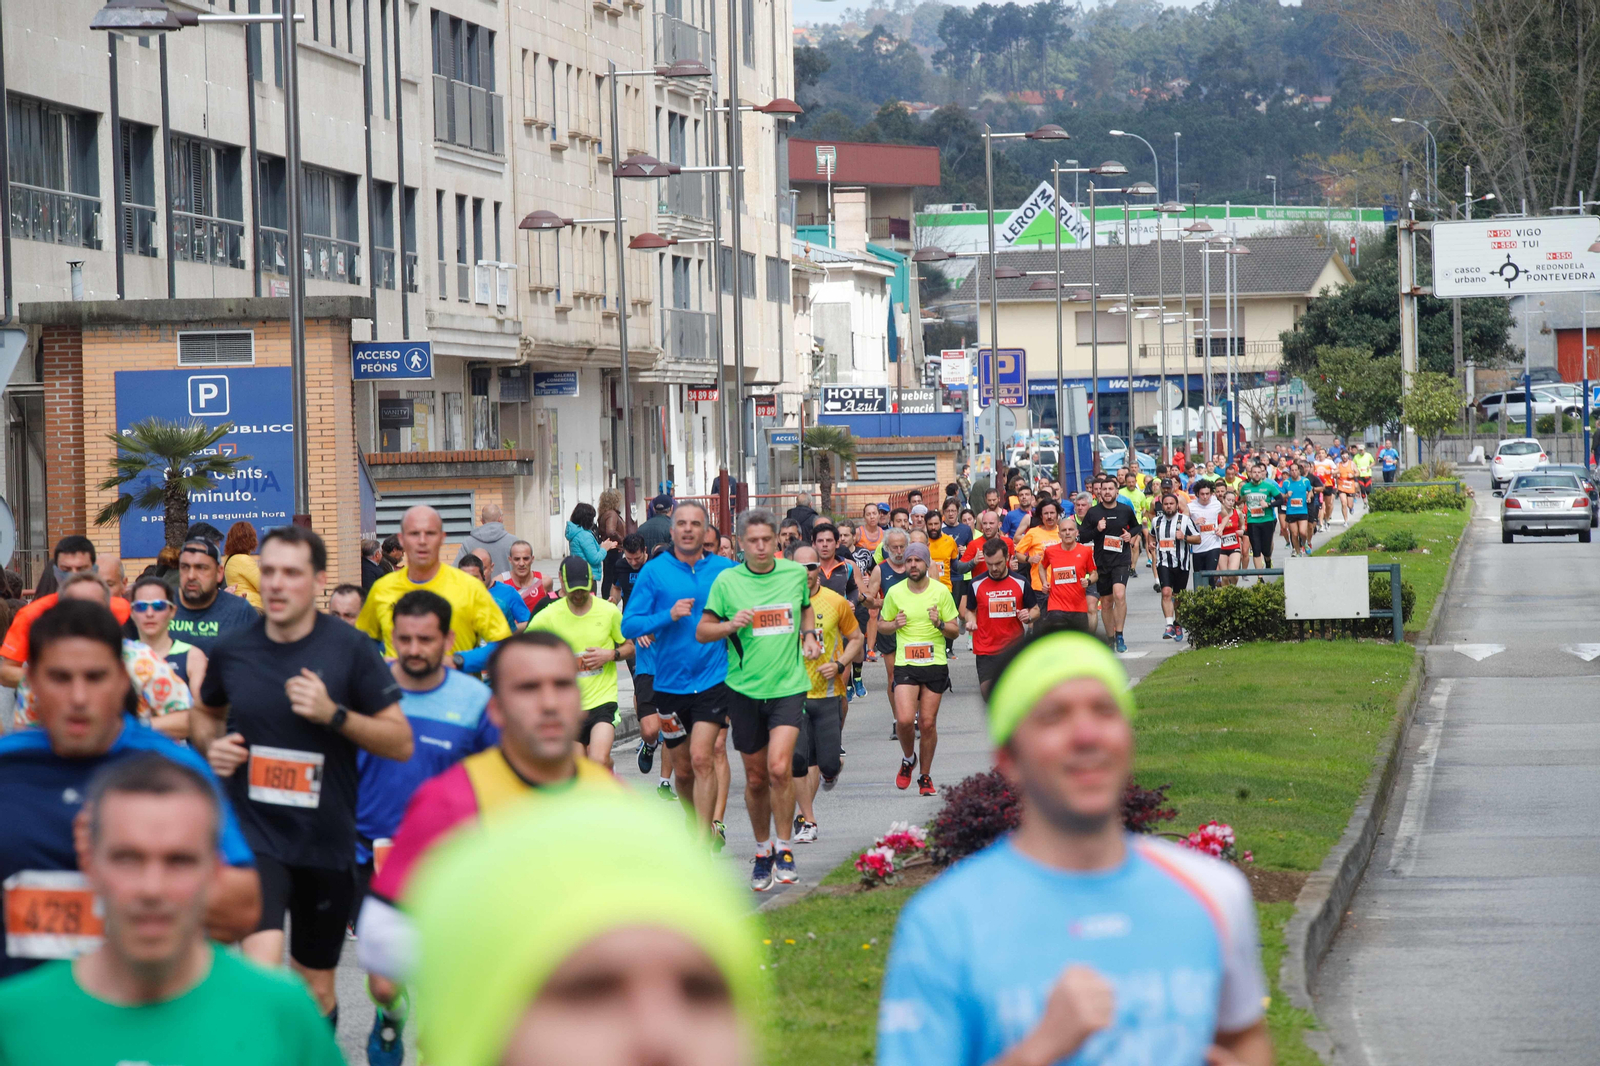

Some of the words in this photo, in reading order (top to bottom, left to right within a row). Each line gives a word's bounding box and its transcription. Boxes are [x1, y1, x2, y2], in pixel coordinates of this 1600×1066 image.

[1002, 197, 1042, 244] LEROY
[1516, 228, 1541, 237] VIGO
[1491, 241, 1517, 249] N-550
[1522, 240, 1539, 248] TUI
[1546, 252, 1572, 260] N-550
[1536, 263, 1585, 271] REDONDELA
[1454, 276, 1487, 284] urbano
[1526, 272, 1596, 282] PONTEVEDRA
[356, 350, 401, 360] ACCESO
[361, 361, 398, 373] PEÓNS
[688, 391, 697, 400] 34
[698, 391, 707, 400] 89
[708, 390, 718, 399] 89
[828, 388, 884, 399] HOTEL
[842, 399, 882, 411] Azul
[757, 407, 766, 415] 89
[766, 406, 775, 415] 89
[199, 512, 208, 520] la
[212, 511, 258, 522] segunda
[262, 510, 286, 518] hora
[1057, 571, 1071, 580] 323
[995, 603, 1008, 612] 129
[167, 619, 194, 631] RUN
[197, 621, 219, 632] ON
[760, 613, 782, 628] 996
[911, 648, 925, 659] 145
[264, 765, 297, 791] 180
